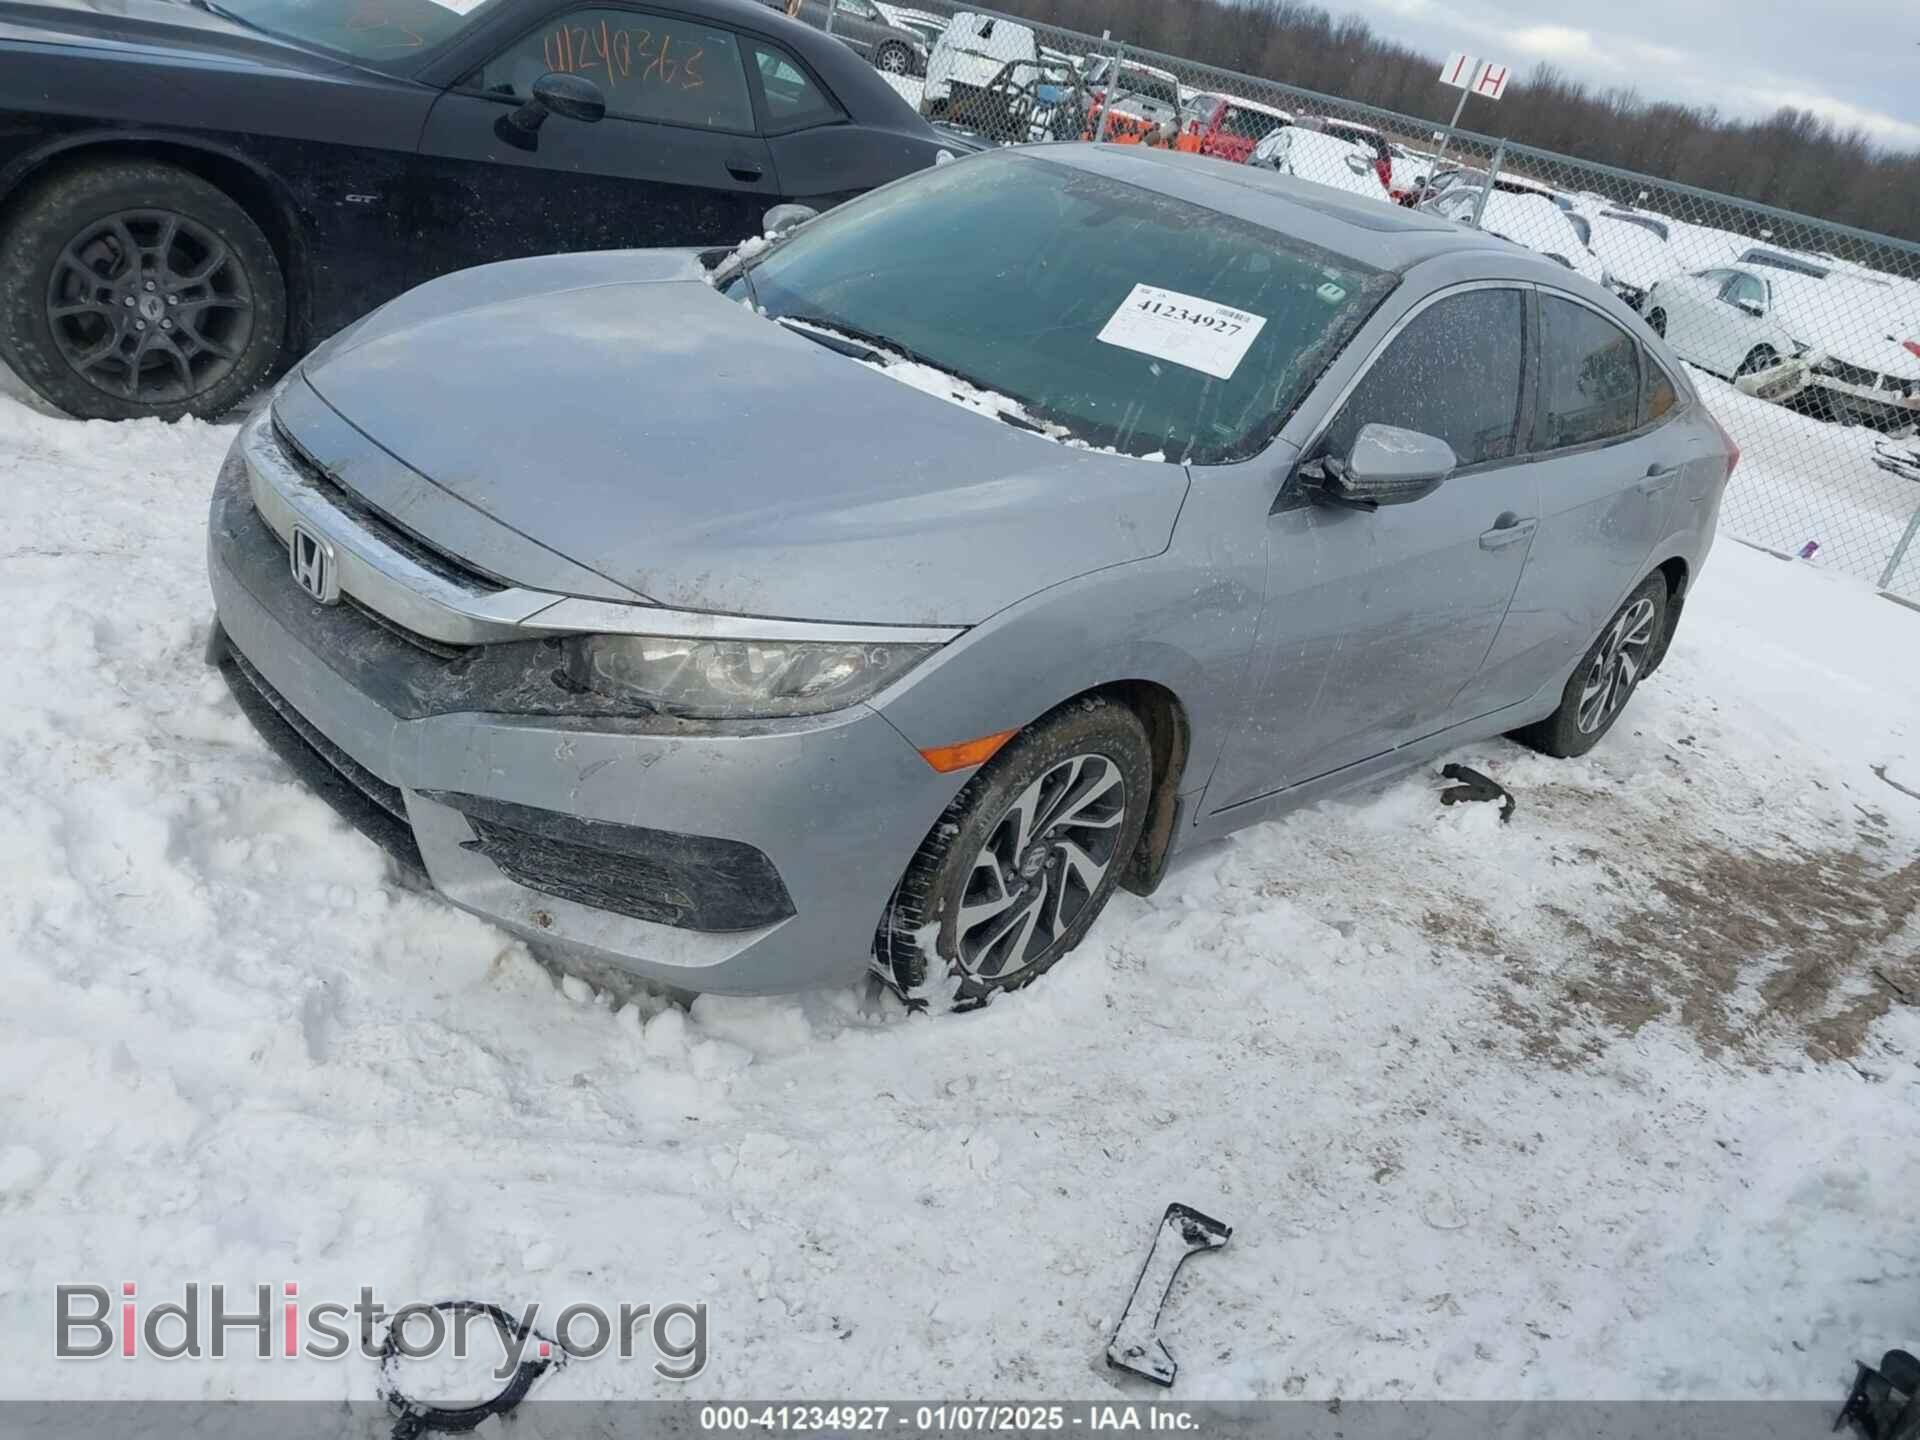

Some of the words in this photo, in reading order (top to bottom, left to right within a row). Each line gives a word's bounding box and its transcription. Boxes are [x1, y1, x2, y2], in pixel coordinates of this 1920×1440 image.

[1478, 63, 1506, 96] H
[345, 194, 378, 204] GT
[1137, 300, 1242, 337] 41234927
